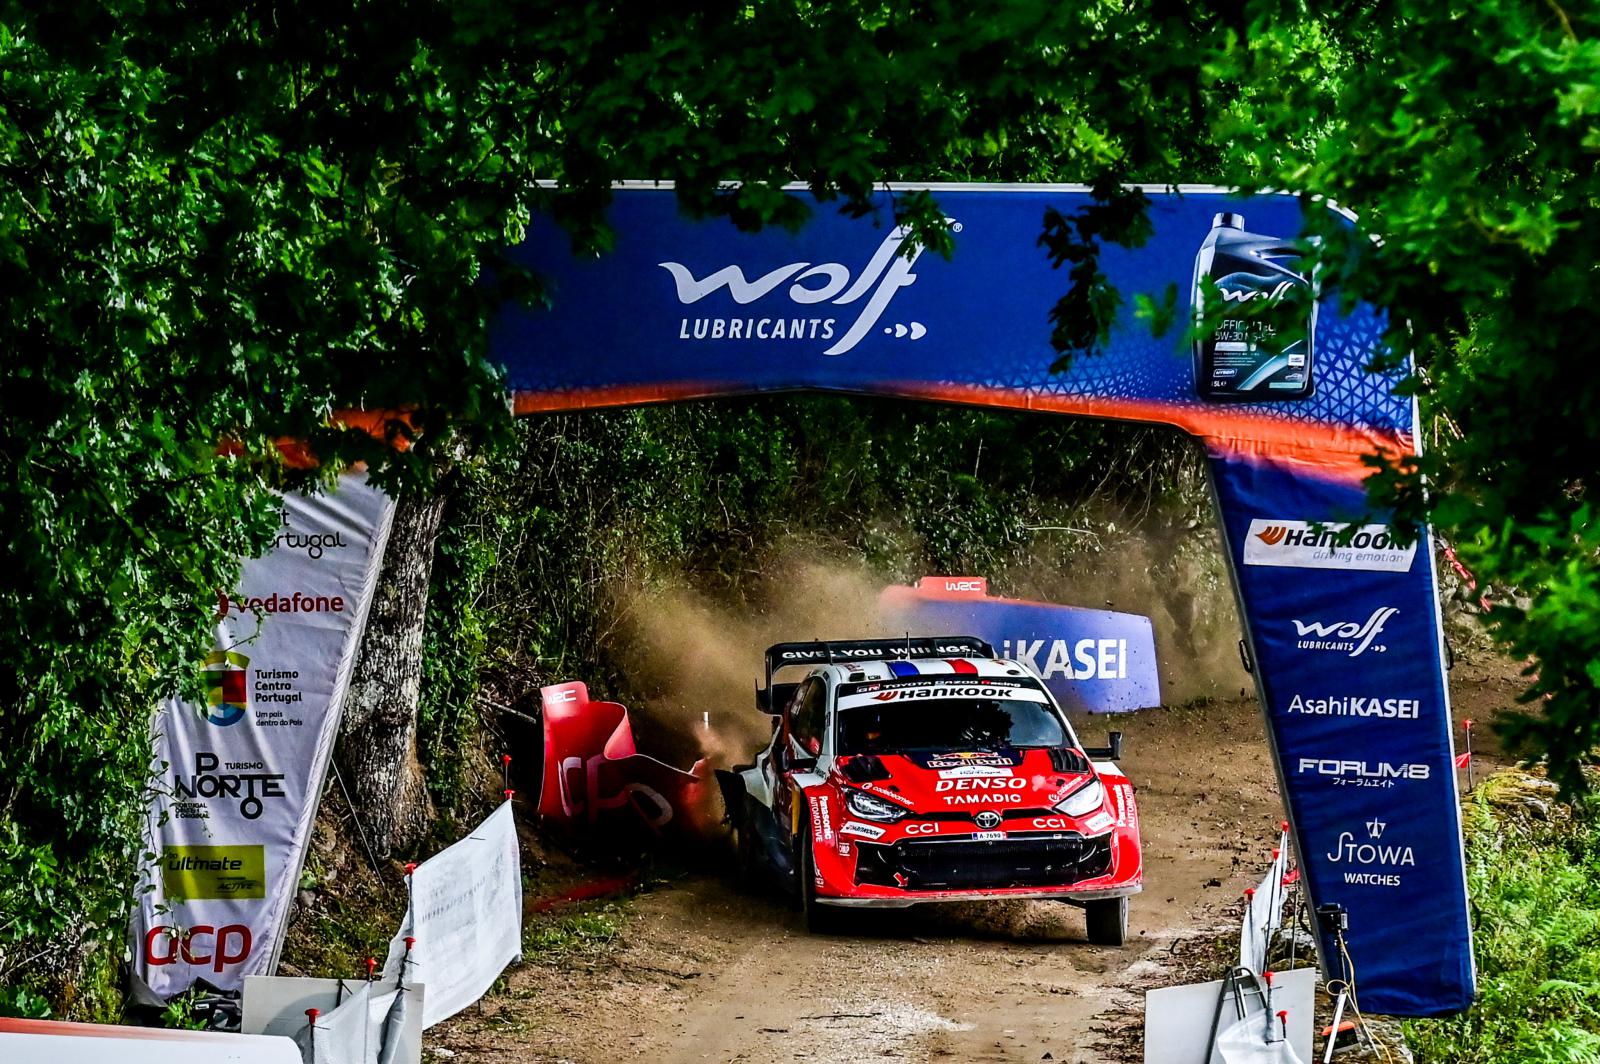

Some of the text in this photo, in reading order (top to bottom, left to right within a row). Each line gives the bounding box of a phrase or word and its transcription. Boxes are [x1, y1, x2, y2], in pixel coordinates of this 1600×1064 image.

[679, 318, 836, 340] LUBRICANTS
[1313, 549, 1404, 563] driving emotion
[946, 581, 981, 591] WRC
[1298, 640, 1354, 651] LUBRICANTS
[841, 649, 883, 657] YOU
[255, 669, 299, 679] Turismo
[255, 681, 292, 690] Centro
[883, 681, 932, 689] TOYOTA
[981, 680, 1022, 688] Racing
[255, 691, 303, 704] Portugal
[1288, 694, 1420, 719] AsahiKASEI
[225, 762, 264, 770] TURISMO
[927, 757, 1014, 768] Red Bull
[1299, 758, 1430, 780] FORUM8
[936, 778, 1027, 792] DENSO
[1333, 777, 1395, 788] フォーラムエイト
[943, 793, 1022, 805] TAMADIC
[809, 796, 823, 843] AUTOMOTIVE
[819, 795, 834, 840] Panasonic
[1032, 818, 1066, 828] CCI
[905, 822, 940, 834] CCI
[168, 856, 243, 871] ultimate
[1344, 872, 1401, 887] WATCHES
